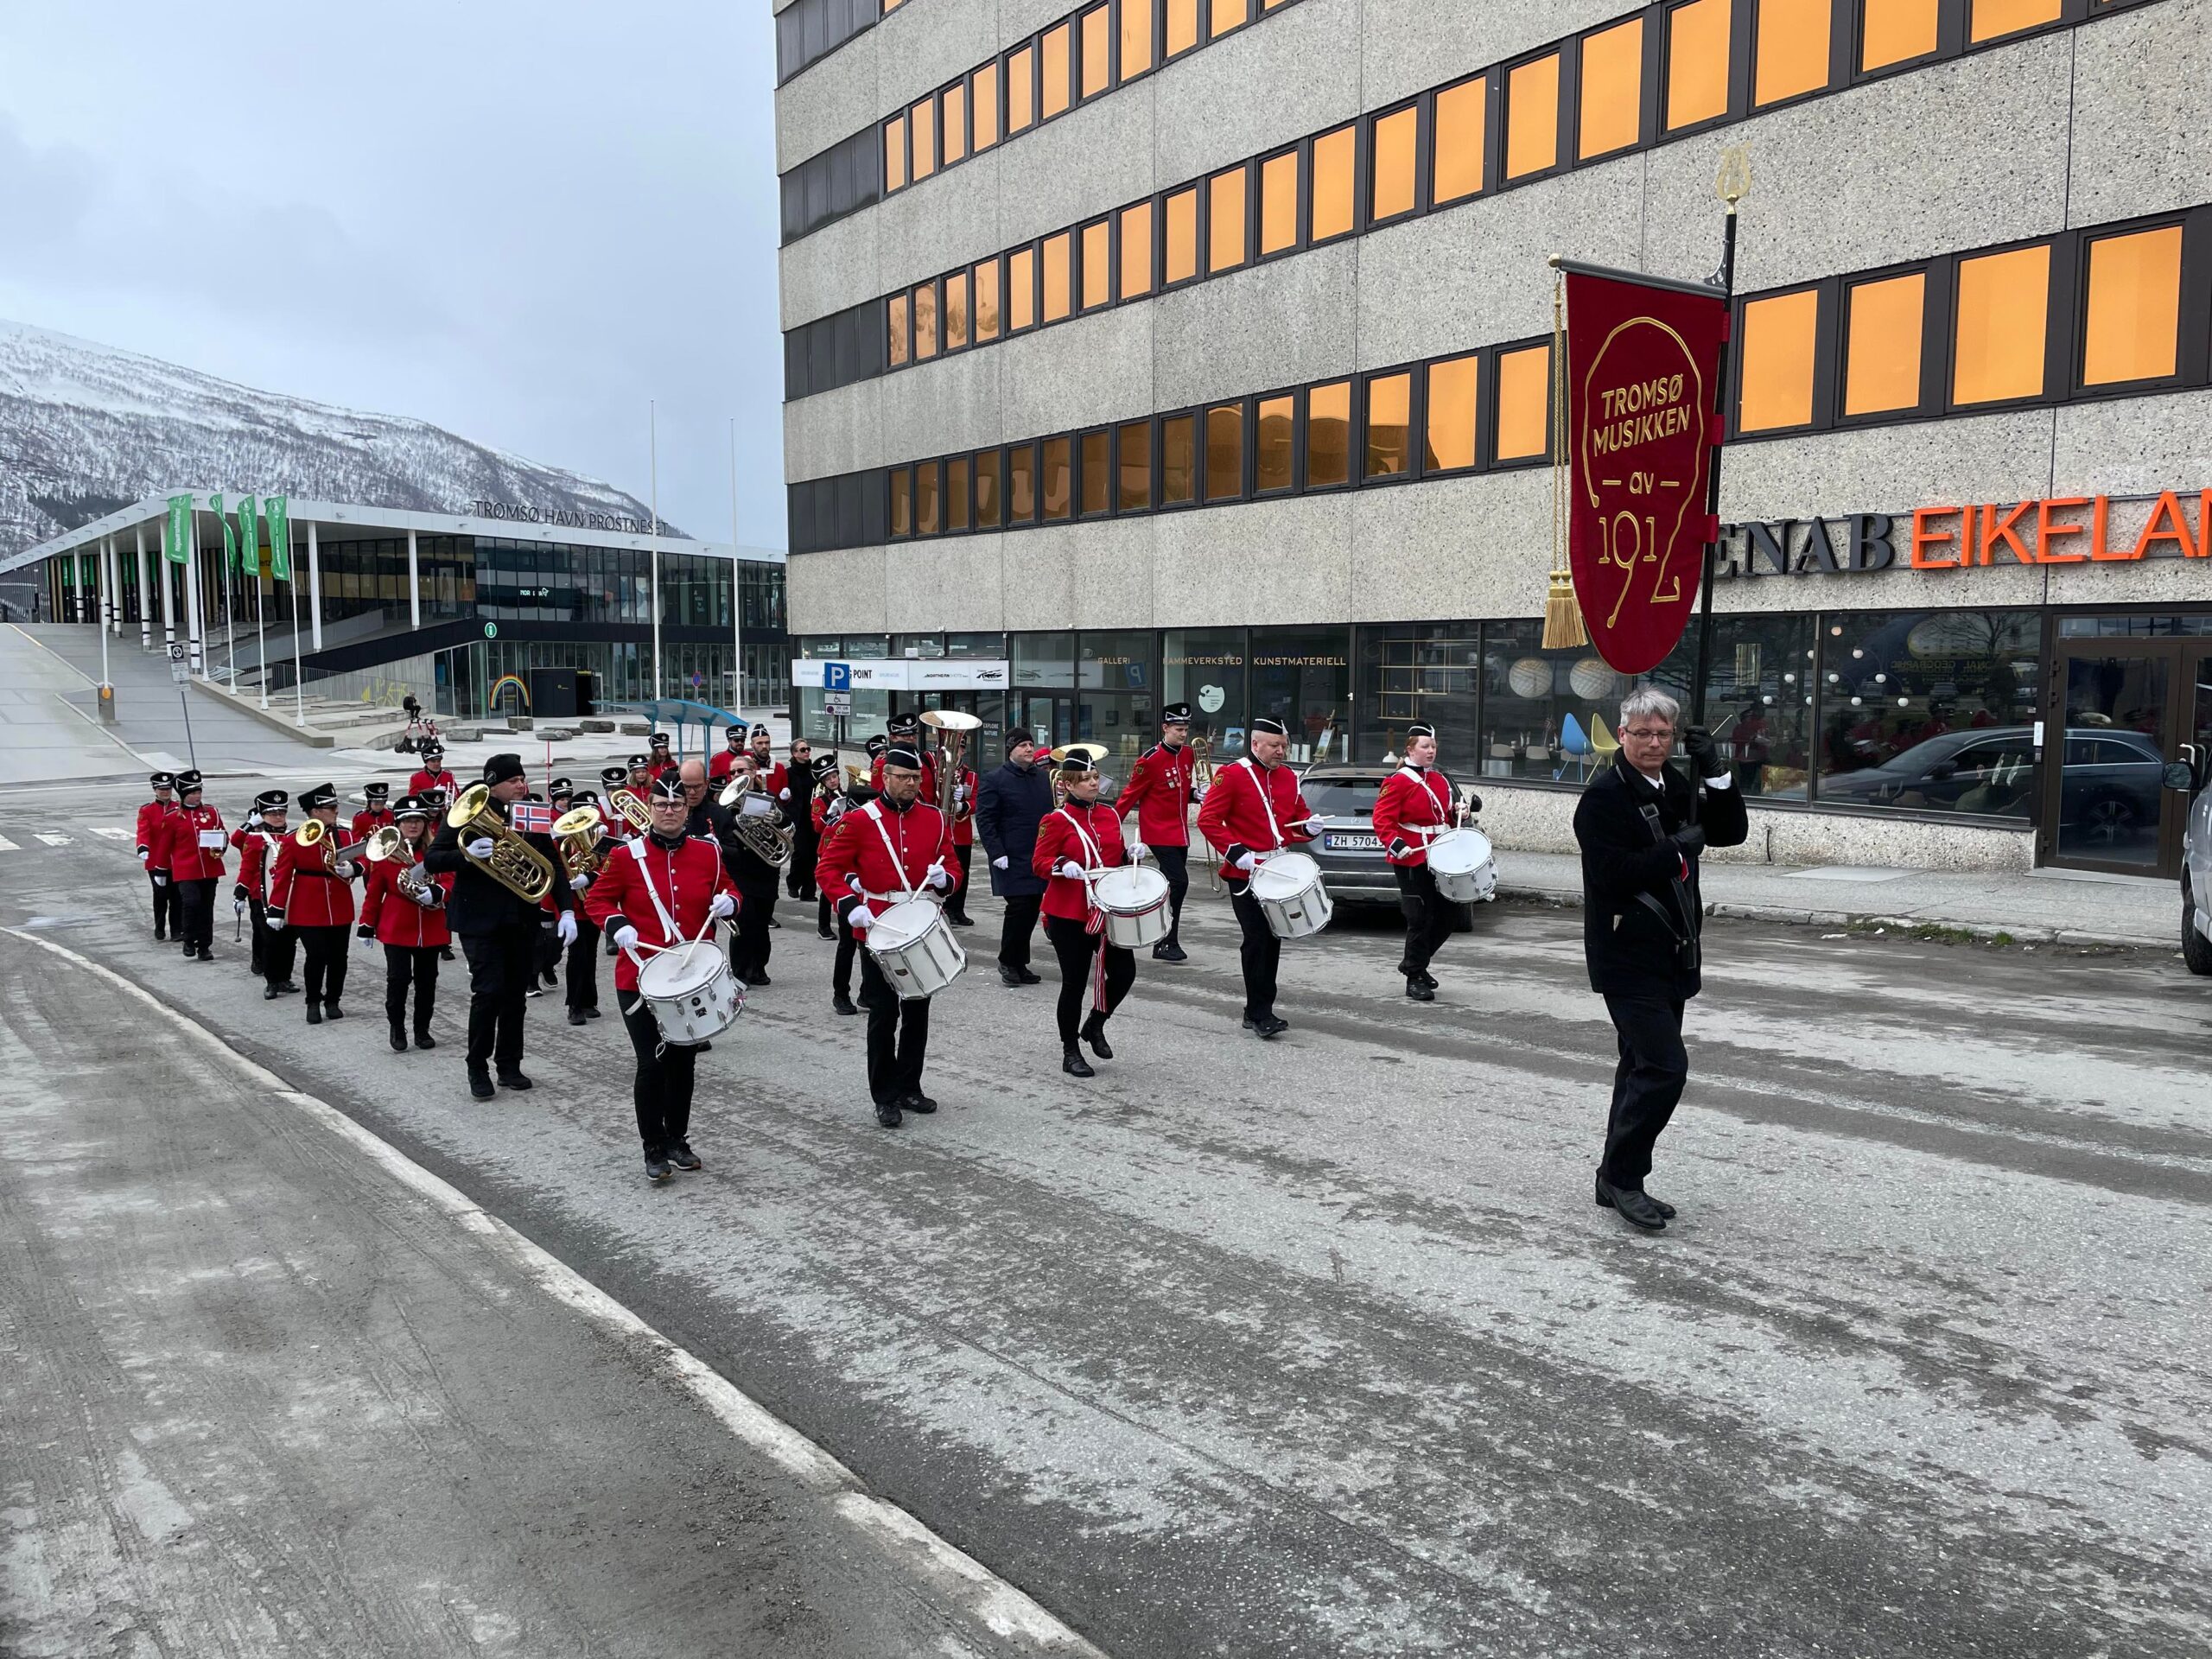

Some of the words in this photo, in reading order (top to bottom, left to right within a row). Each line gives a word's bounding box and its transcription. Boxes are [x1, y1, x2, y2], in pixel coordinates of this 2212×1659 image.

[1601, 373, 1683, 419] TROMSØ
[1592, 404, 1691, 457] MUSIKKEN
[1629, 472, 1654, 494] av
[474, 500, 540, 523] TROMSØ
[544, 508, 584, 527] HAVN
[589, 513, 668, 536] PROSTNESET
[1254, 657, 1346, 665] KUNSTMATERIELL
[831, 666, 845, 687] P
[853, 670, 873, 679] POINT
[1333, 836, 1347, 846] ZH
